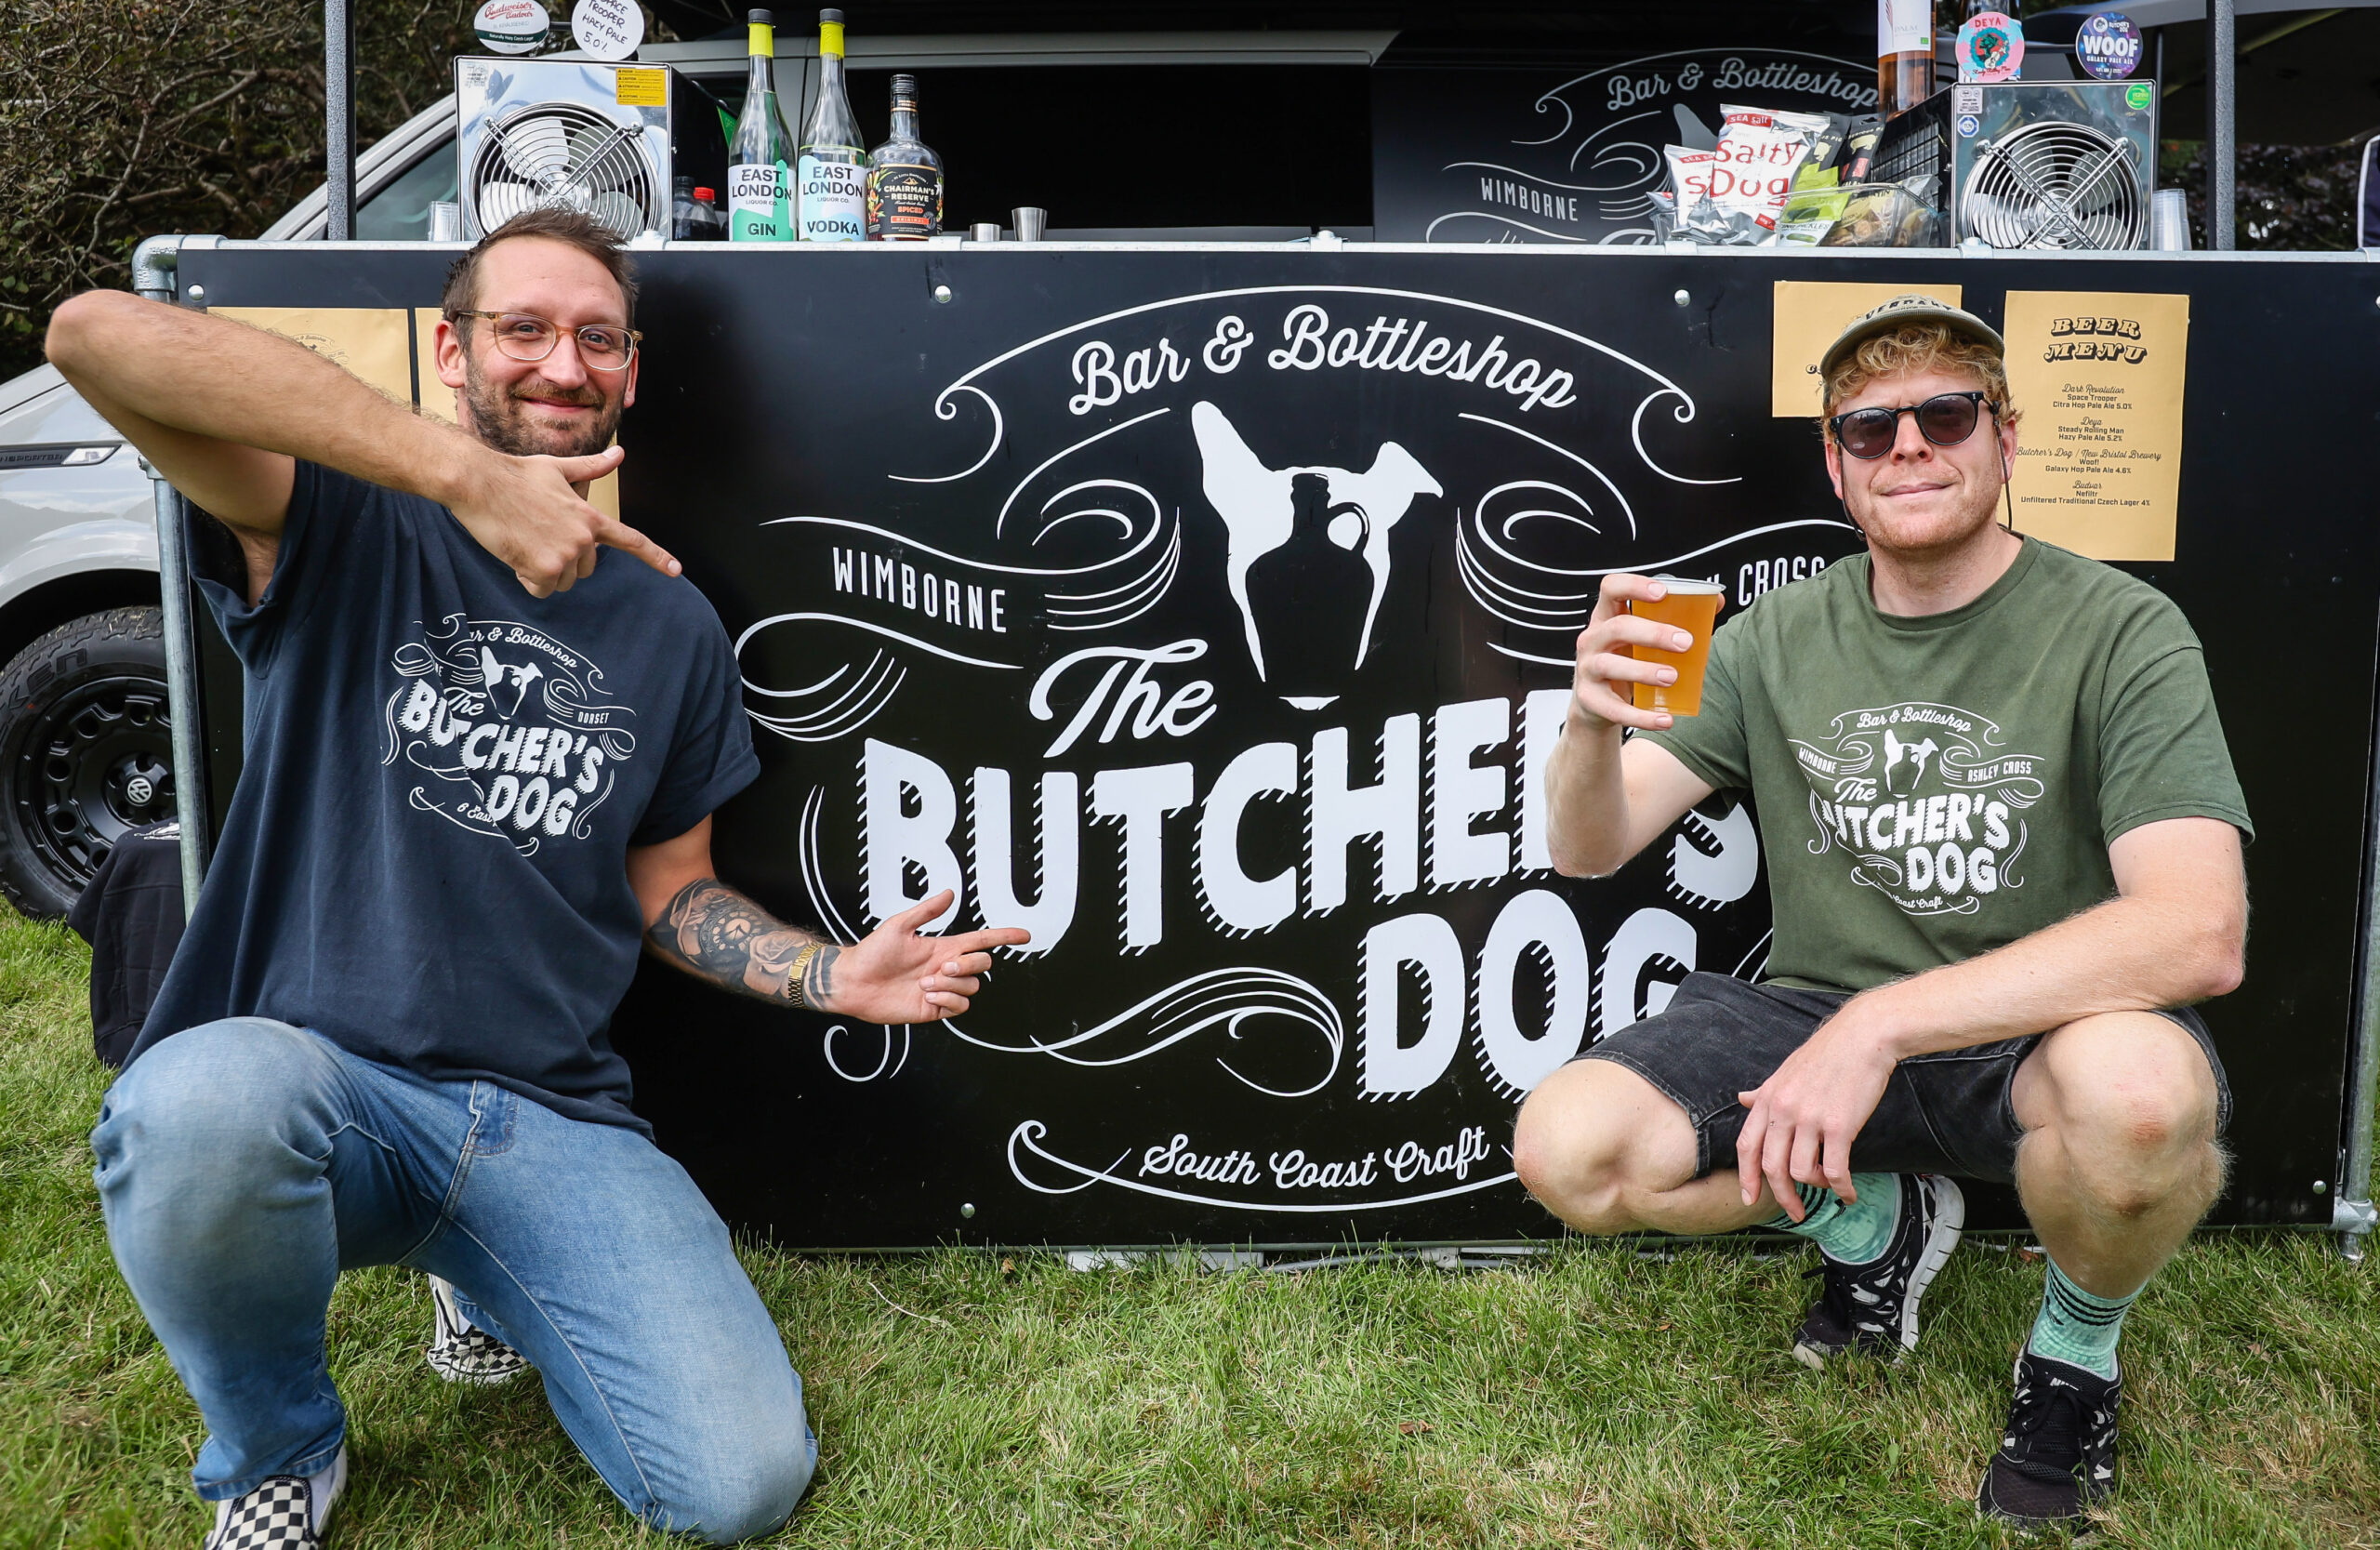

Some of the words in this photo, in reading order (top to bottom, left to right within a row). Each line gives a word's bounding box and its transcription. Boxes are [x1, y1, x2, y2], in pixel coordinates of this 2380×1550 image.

[582, 14, 605, 31] HAZY
[605, 27, 628, 44] PALE
[1975, 17, 2001, 28] DEYA
[2083, 35, 2138, 57] WOOF
[1607, 75, 1672, 111] Bar
[1678, 62, 1704, 90] &
[1712, 57, 1879, 109] Bottleshop
[1729, 114, 1749, 123] SEA
[1714, 139, 1801, 166] Salty
[741, 168, 783, 182] EAST
[813, 166, 853, 179] EAST
[732, 184, 792, 201] LONDON
[802, 181, 863, 198] LONDON
[883, 185, 935, 196] CHAIRMAN'S
[891, 192, 929, 203] RESERVE
[1481, 177, 1579, 222] WIMBORNE
[897, 205, 924, 214] SPICED
[747, 222, 776, 237] GIN
[807, 219, 860, 235] VODKA
[2050, 317, 2141, 340] BEER
[1068, 338, 1191, 416] Bar
[1203, 315, 1254, 374] &
[1268, 304, 1577, 412] Bottleshop
[2043, 342, 2148, 364] MENU
[2062, 383, 2083, 392] Dark
[2085, 383, 2125, 396] Revolution
[2067, 393, 2088, 402] Space
[2081, 416, 2102, 428] Deya
[2016, 446, 2053, 456] Butcher's
[2055, 447, 2072, 459] Dog
[2082, 449, 2098, 459] New
[2099, 448, 2127, 458] Bristol
[2128, 450, 2162, 461] Brewery
[2072, 480, 2102, 489] Budvar
[833, 547, 1007, 633] WIMBORNE
[487, 627, 503, 642] &
[505, 627, 577, 668] Bottleshop
[443, 687, 487, 716] The
[1029, 639, 1217, 758] The
[577, 711, 610, 723] DORSET
[1857, 712, 1887, 728] Bar
[1889, 709, 1900, 723] &
[1901, 706, 1972, 732] Bottleshop
[1798, 747, 1838, 774] WIMBORNE
[1967, 764, 1999, 783] ASHLEY
[2003, 762, 2032, 775] CROSS
[1833, 776, 1877, 802] The
[485, 775, 578, 836] DOG
[856, 689, 1758, 962] BUTCHES
[1906, 842, 1997, 894] DOG
[1916, 896, 1943, 909] Craft
[1357, 889, 1697, 1104] DOG
[1139, 1133, 1261, 1185] South
[1269, 1149, 1378, 1189] Coast
[1384, 1126, 1490, 1180] Craft
